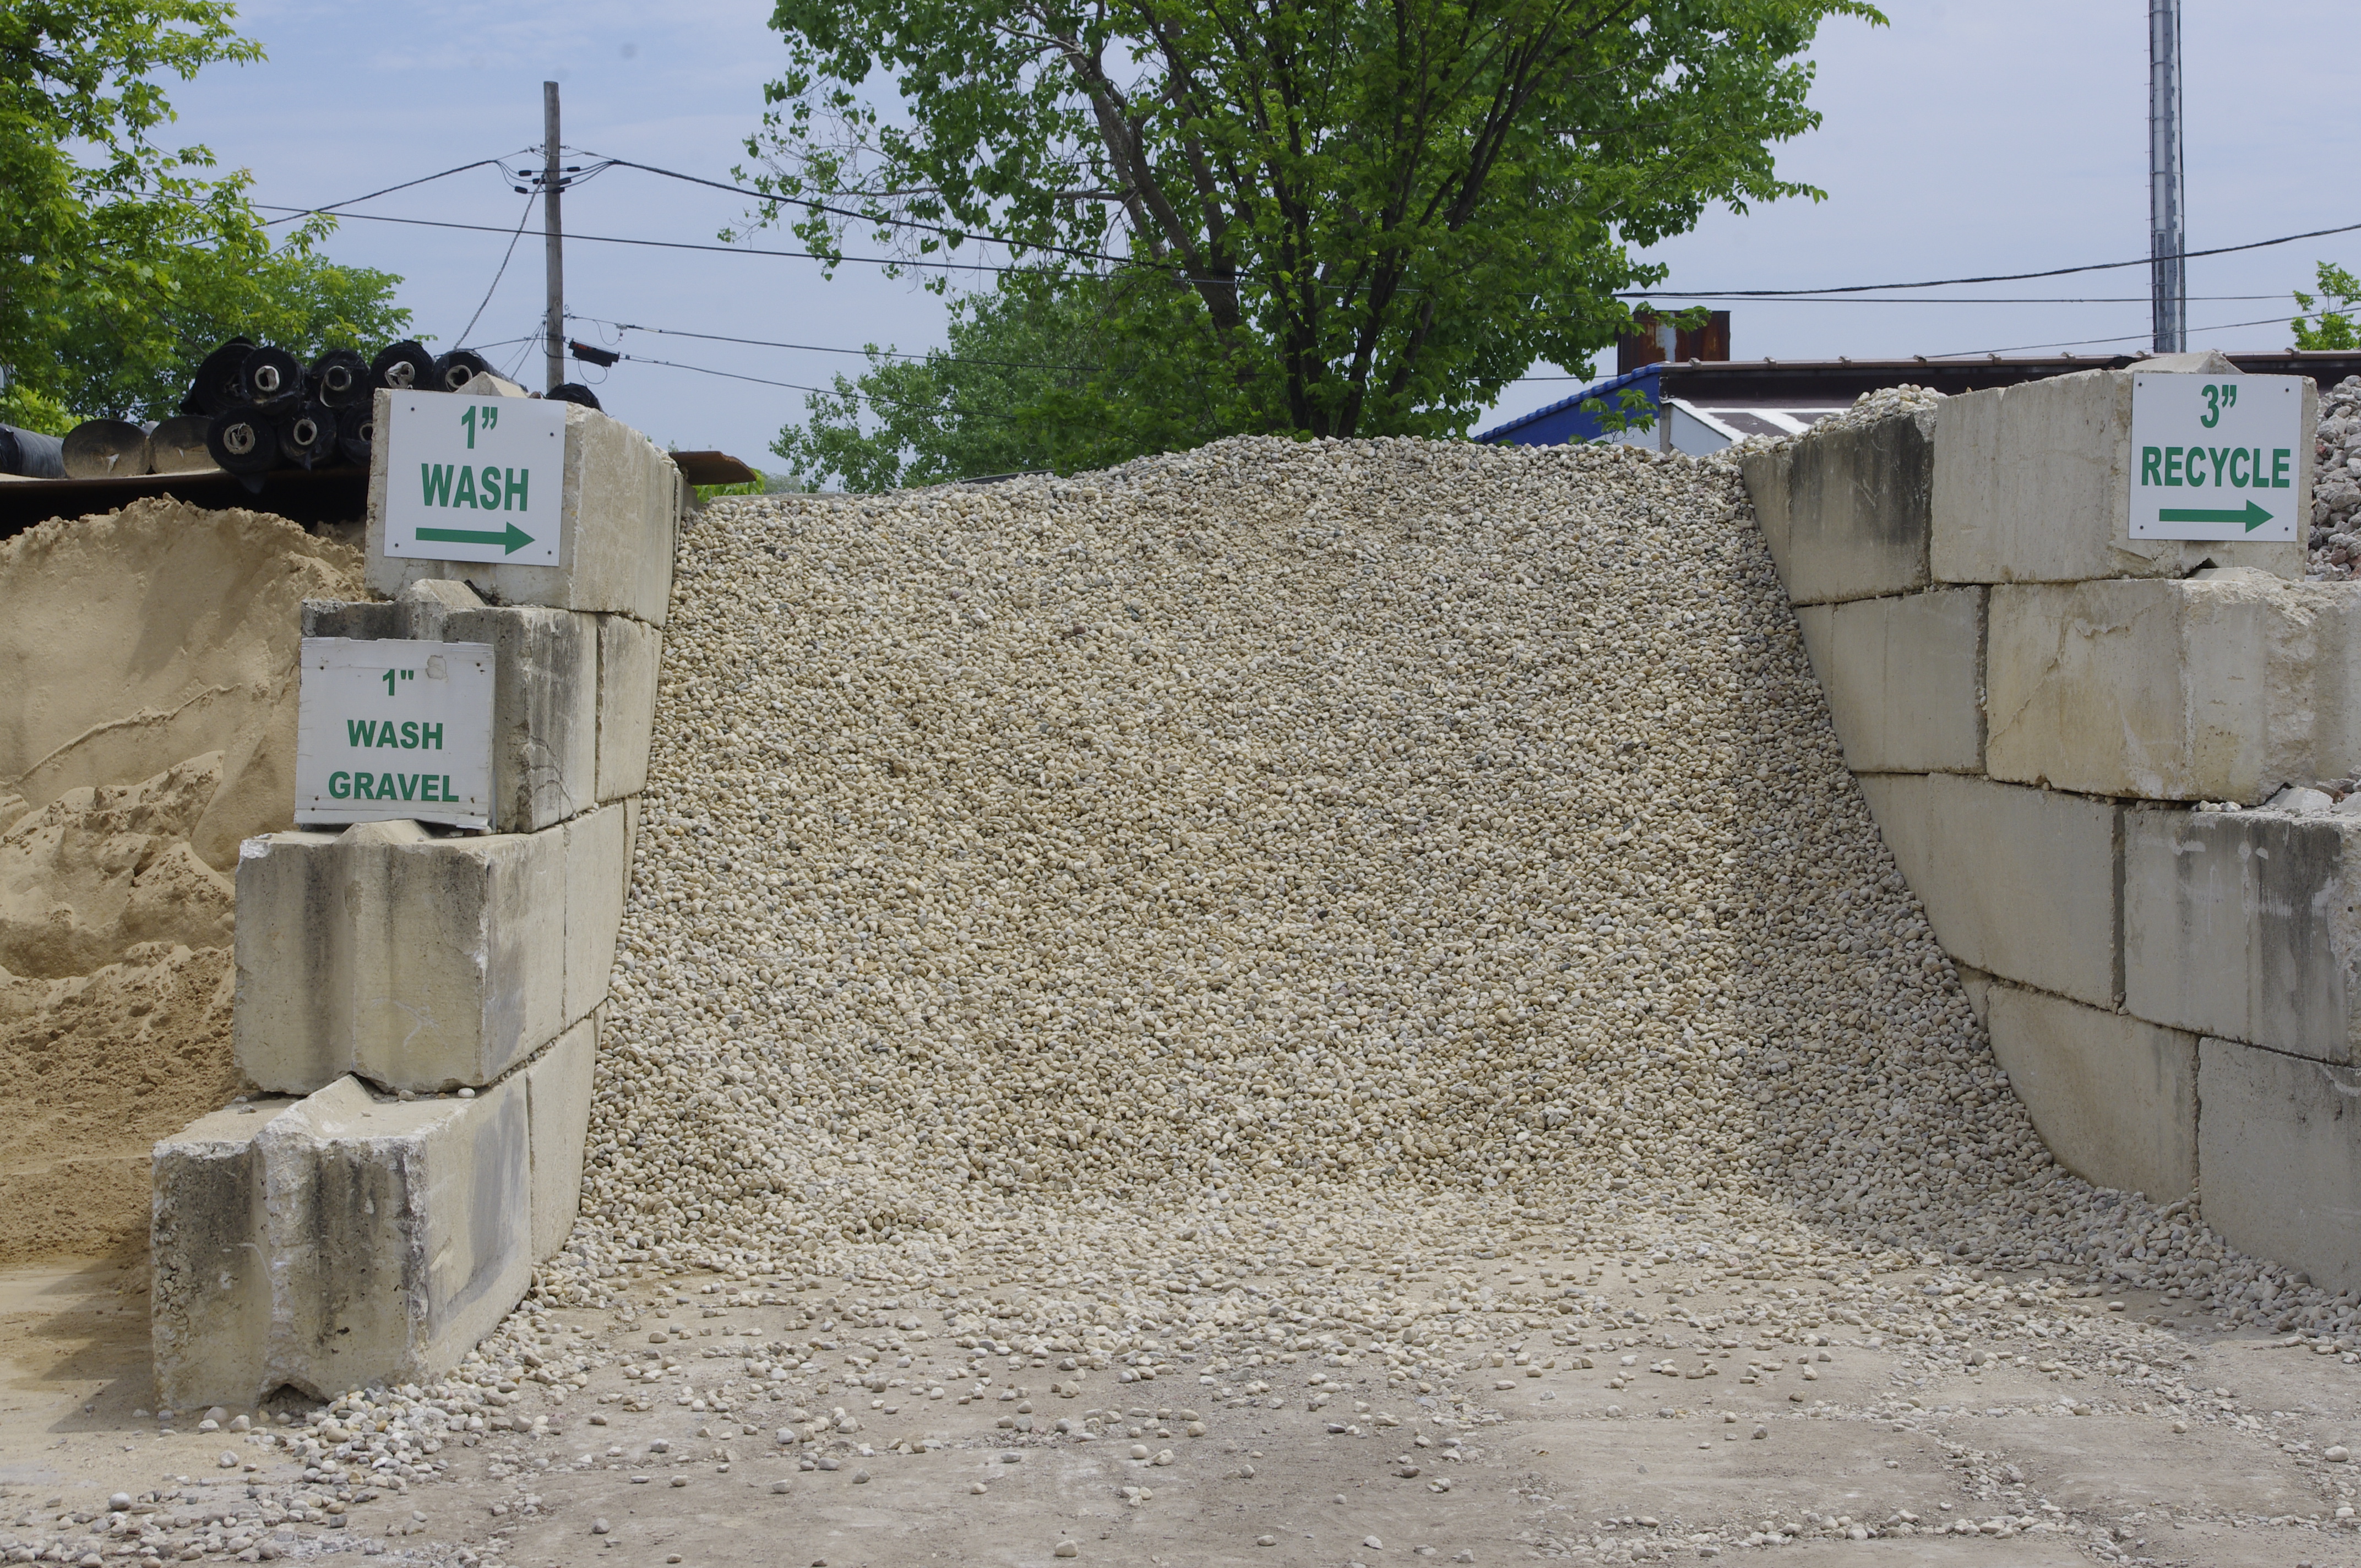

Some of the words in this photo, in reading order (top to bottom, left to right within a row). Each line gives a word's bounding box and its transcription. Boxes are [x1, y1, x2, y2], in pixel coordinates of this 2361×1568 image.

[2141, 446, 2291, 488] RECYCLE
[421, 463, 529, 511] WASH
[347, 720, 443, 750] WASH
[328, 771, 459, 802] GRAVEL
